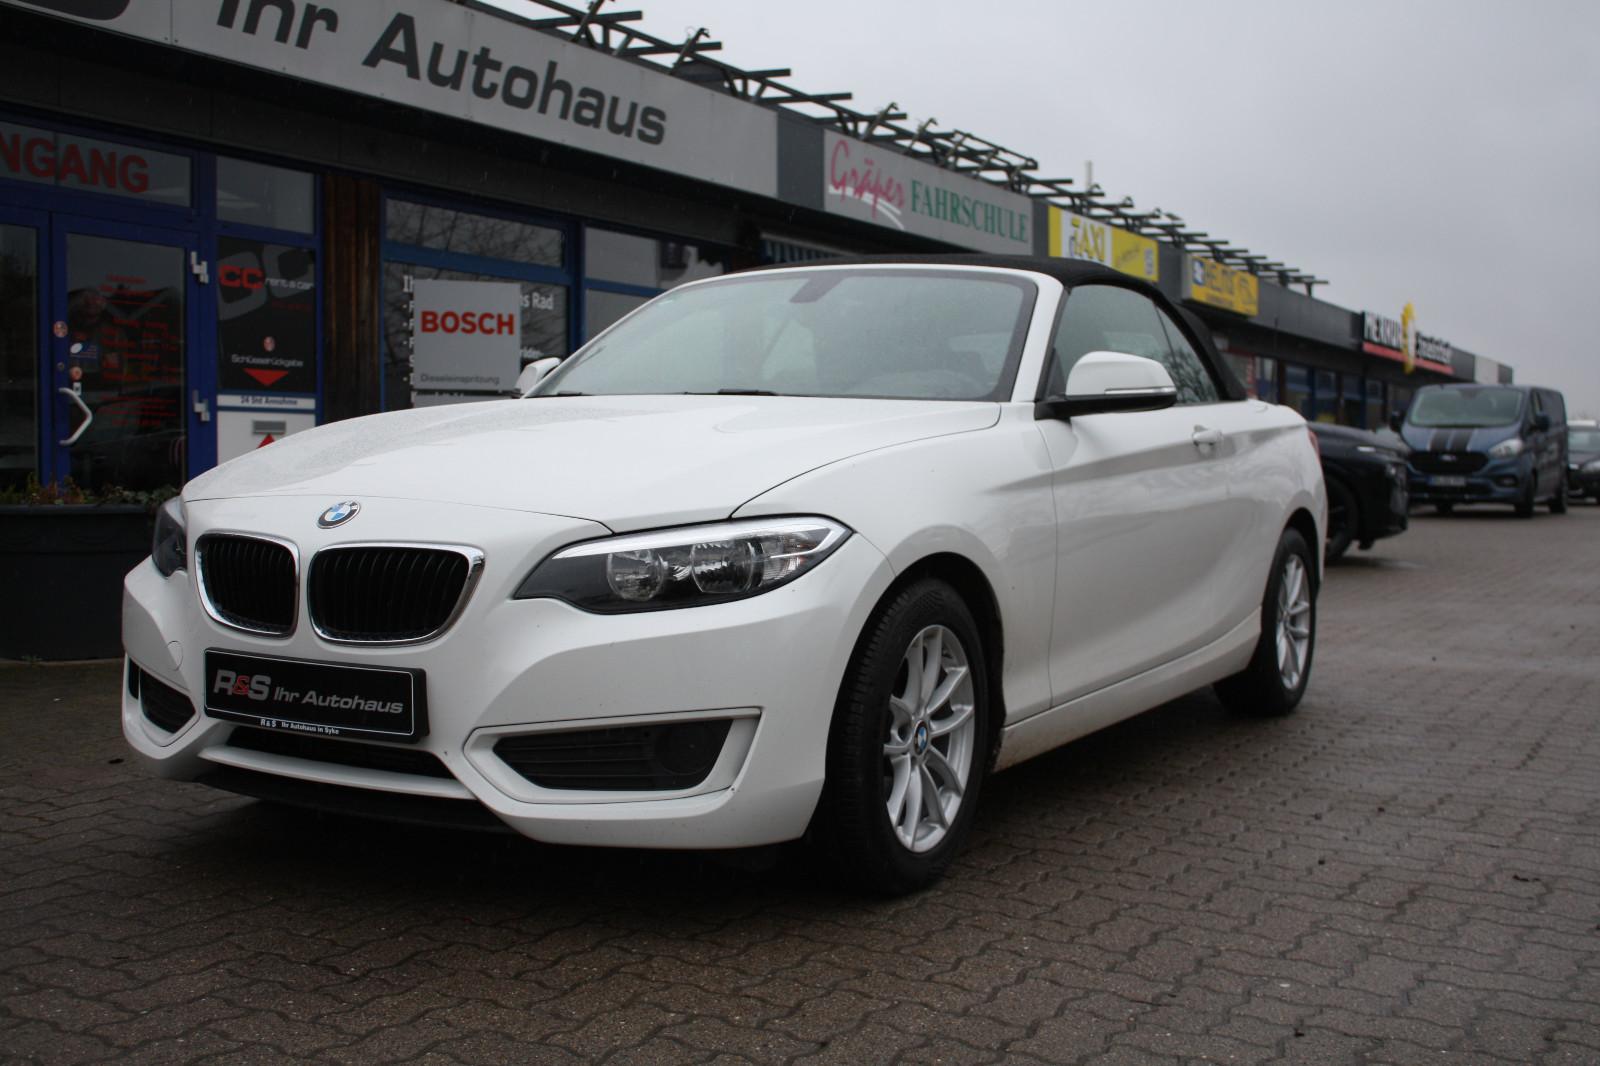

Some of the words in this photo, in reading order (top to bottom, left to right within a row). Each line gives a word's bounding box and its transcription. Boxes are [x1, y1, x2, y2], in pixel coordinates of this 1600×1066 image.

[362, 12, 667, 146] Autohaus
[911, 179, 1028, 243] FAHRSCHULE
[1069, 217, 1105, 262] TAXI
[531, 292, 554, 310] Rad
[421, 310, 514, 335] BOSCH
[420, 372, 500, 386] Dieseleinspritzung
[213, 668, 272, 702] R&S
[274, 686, 300, 703] Ihr
[301, 690, 404, 714] Autohaus
[290, 722, 317, 733] Autohaus
